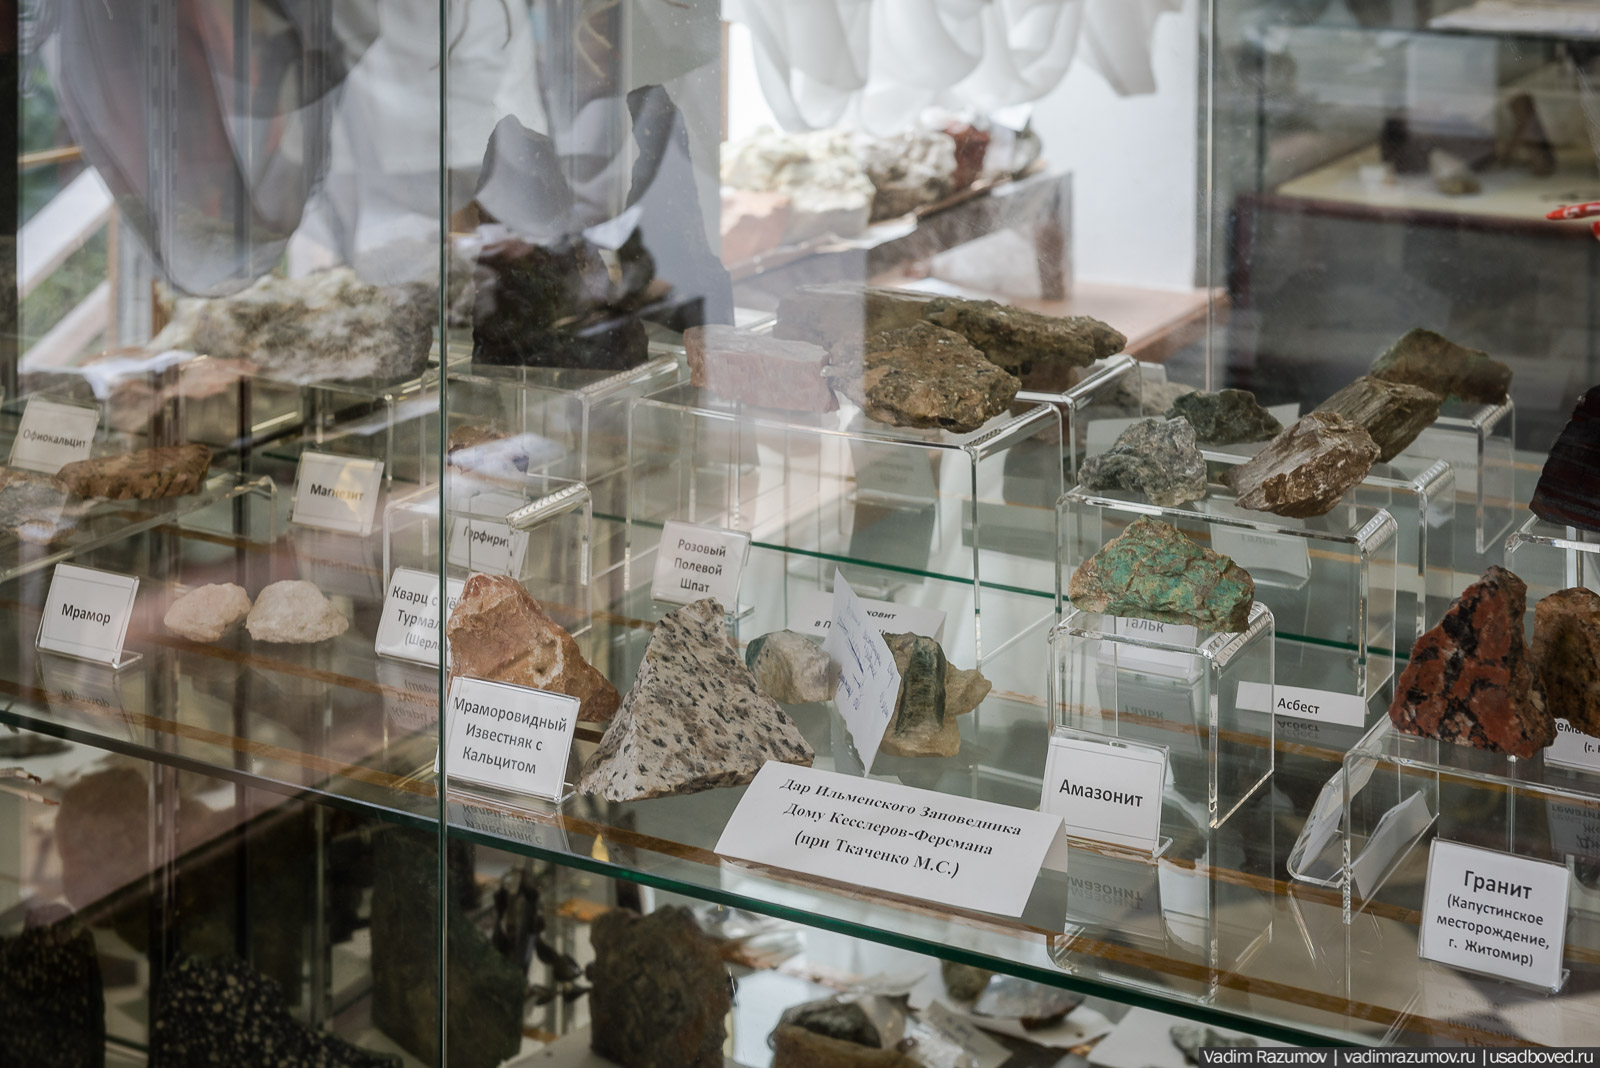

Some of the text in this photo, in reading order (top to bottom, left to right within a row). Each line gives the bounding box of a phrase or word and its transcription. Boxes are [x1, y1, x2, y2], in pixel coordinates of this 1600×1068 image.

[23, 429, 86, 448] Офиокальцит
[310, 483, 364, 501] Магнезит
[677, 539, 726, 557] Розовый
[674, 557, 722, 576] Полевой
[392, 585, 428, 607] Кварц
[680, 578, 710, 593] Шпат
[61, 603, 111, 626] Мрамор
[454, 697, 567, 732] Мраморовидный
[1277, 697, 1320, 714] Асбест
[466, 723, 543, 751] Известняк с
[462, 746, 536, 774] Кальцитом
[1059, 778, 1143, 807] Амазонит
[779, 779, 1022, 836] Дар Ильменского Заповедника
[783, 803, 993, 855] Дому Кесслеров-Ферсмана
[795, 830, 959, 879] (при Ткаченко М.С.)
[1464, 870, 1532, 899] Гранит
[1447, 893, 1544, 925] (Капустинское
[1436, 915, 1550, 950] месторождение,
[1449, 938, 1533, 967] г. Житомир)
